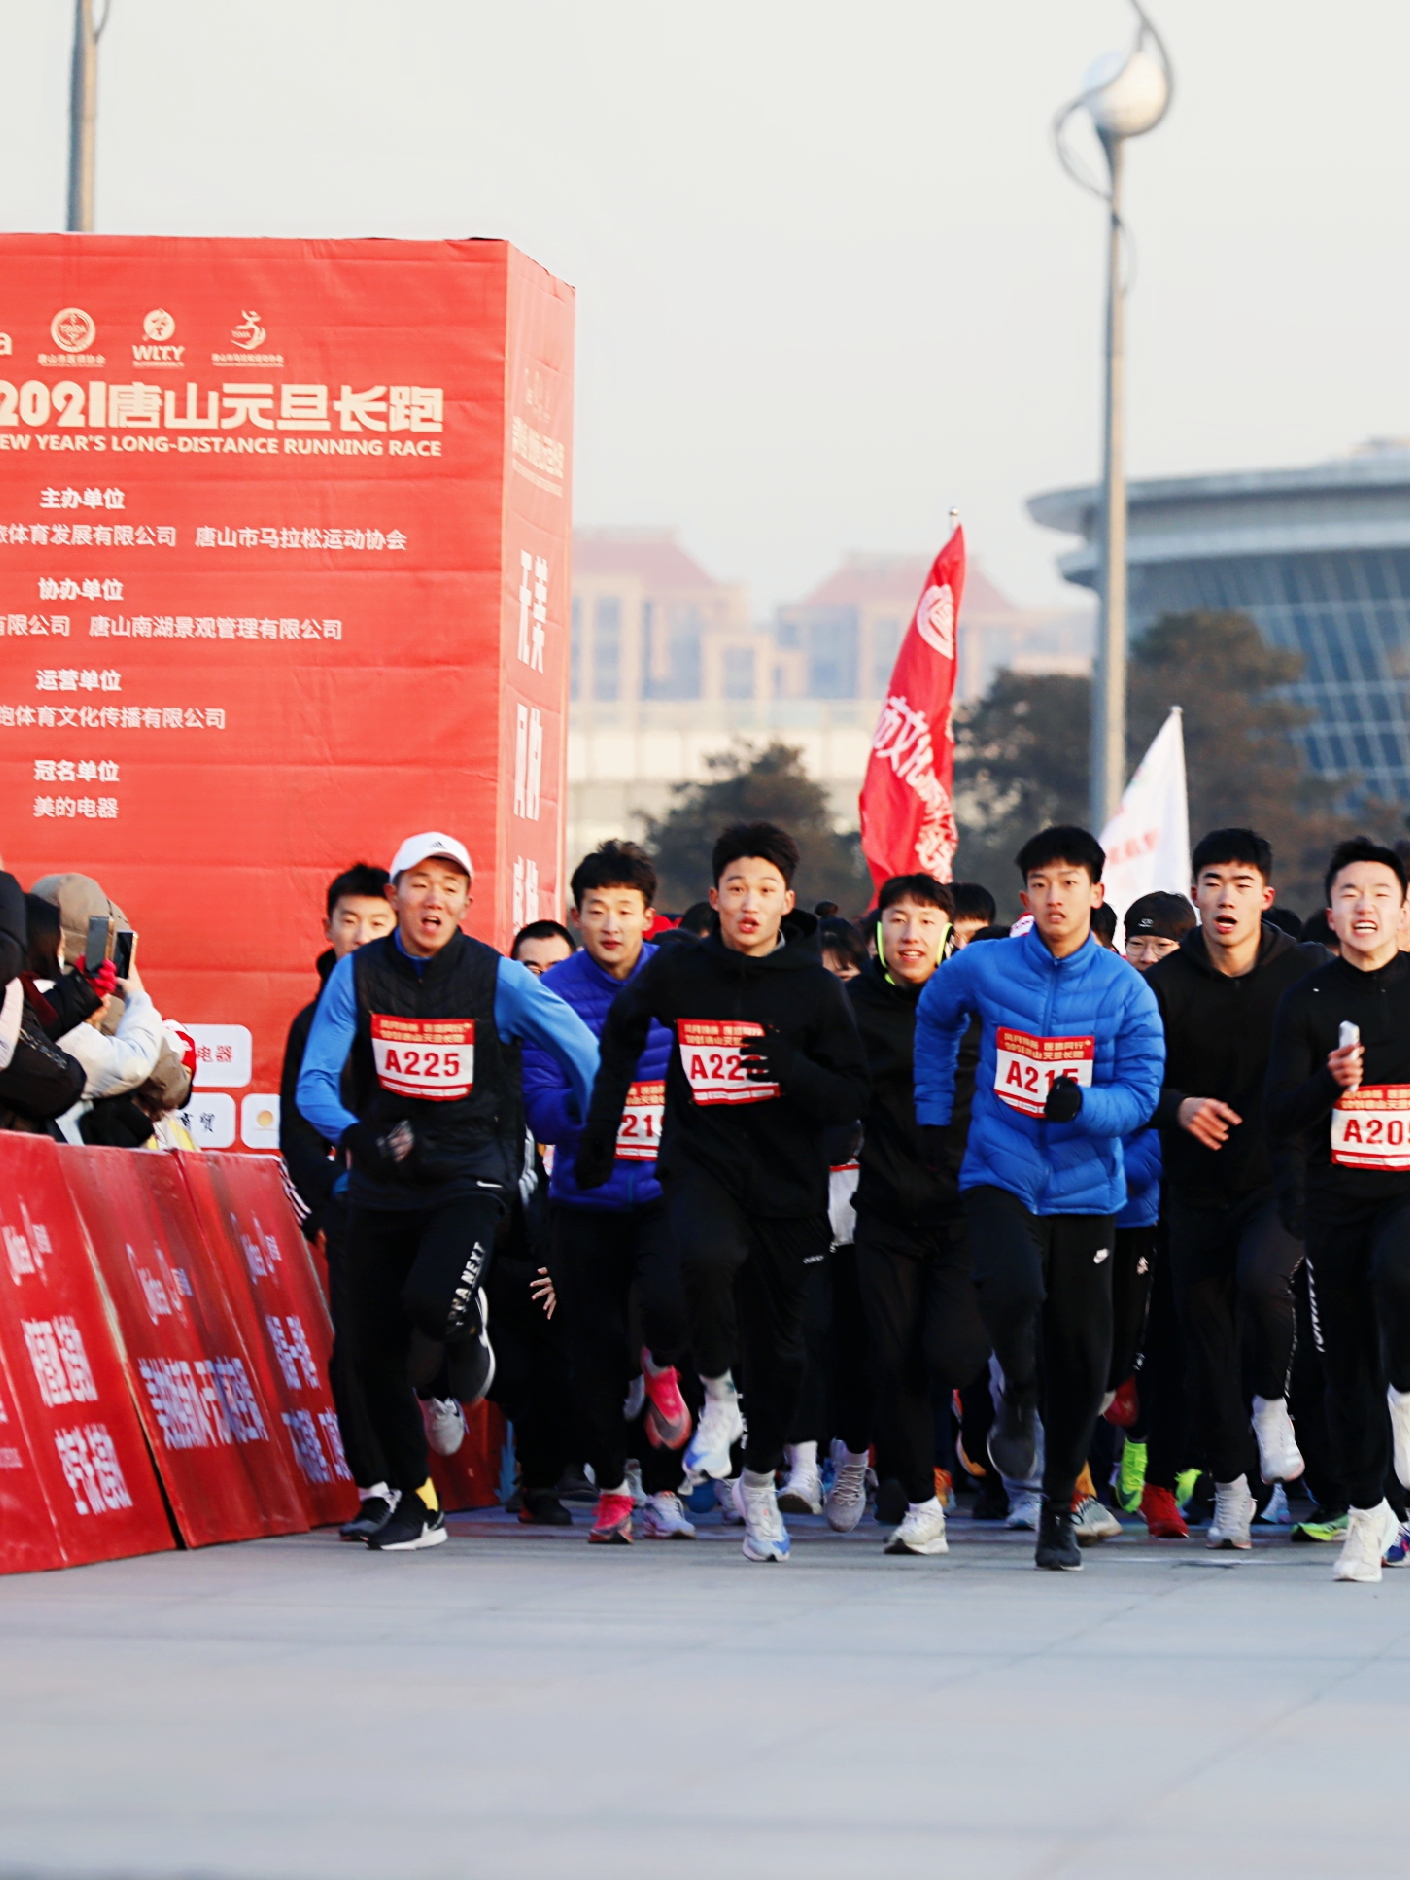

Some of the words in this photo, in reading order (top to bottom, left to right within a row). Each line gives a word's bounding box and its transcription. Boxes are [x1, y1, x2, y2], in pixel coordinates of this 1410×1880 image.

[0, 380, 443, 433] 2021唐山元旦长跑
[36, 434, 106, 453] YEAR'S
[112, 436, 279, 455] LONG-DISTANCE
[284, 440, 383, 456] RUNNING
[389, 441, 442, 457] RACE
[40, 487, 126, 510] 主办单位
[195, 526, 408, 551] 唐山市马拉松运动协会
[38, 578, 124, 601] 协办单位
[89, 616, 343, 641] 唐山南湖景观管理有限公司
[36, 669, 122, 692] 运营单位
[33, 759, 120, 783] 冠名单位
[33, 796, 119, 819] 美的电器
[385, 1049, 460, 1077] A225
[616, 1114, 665, 1137] 21
